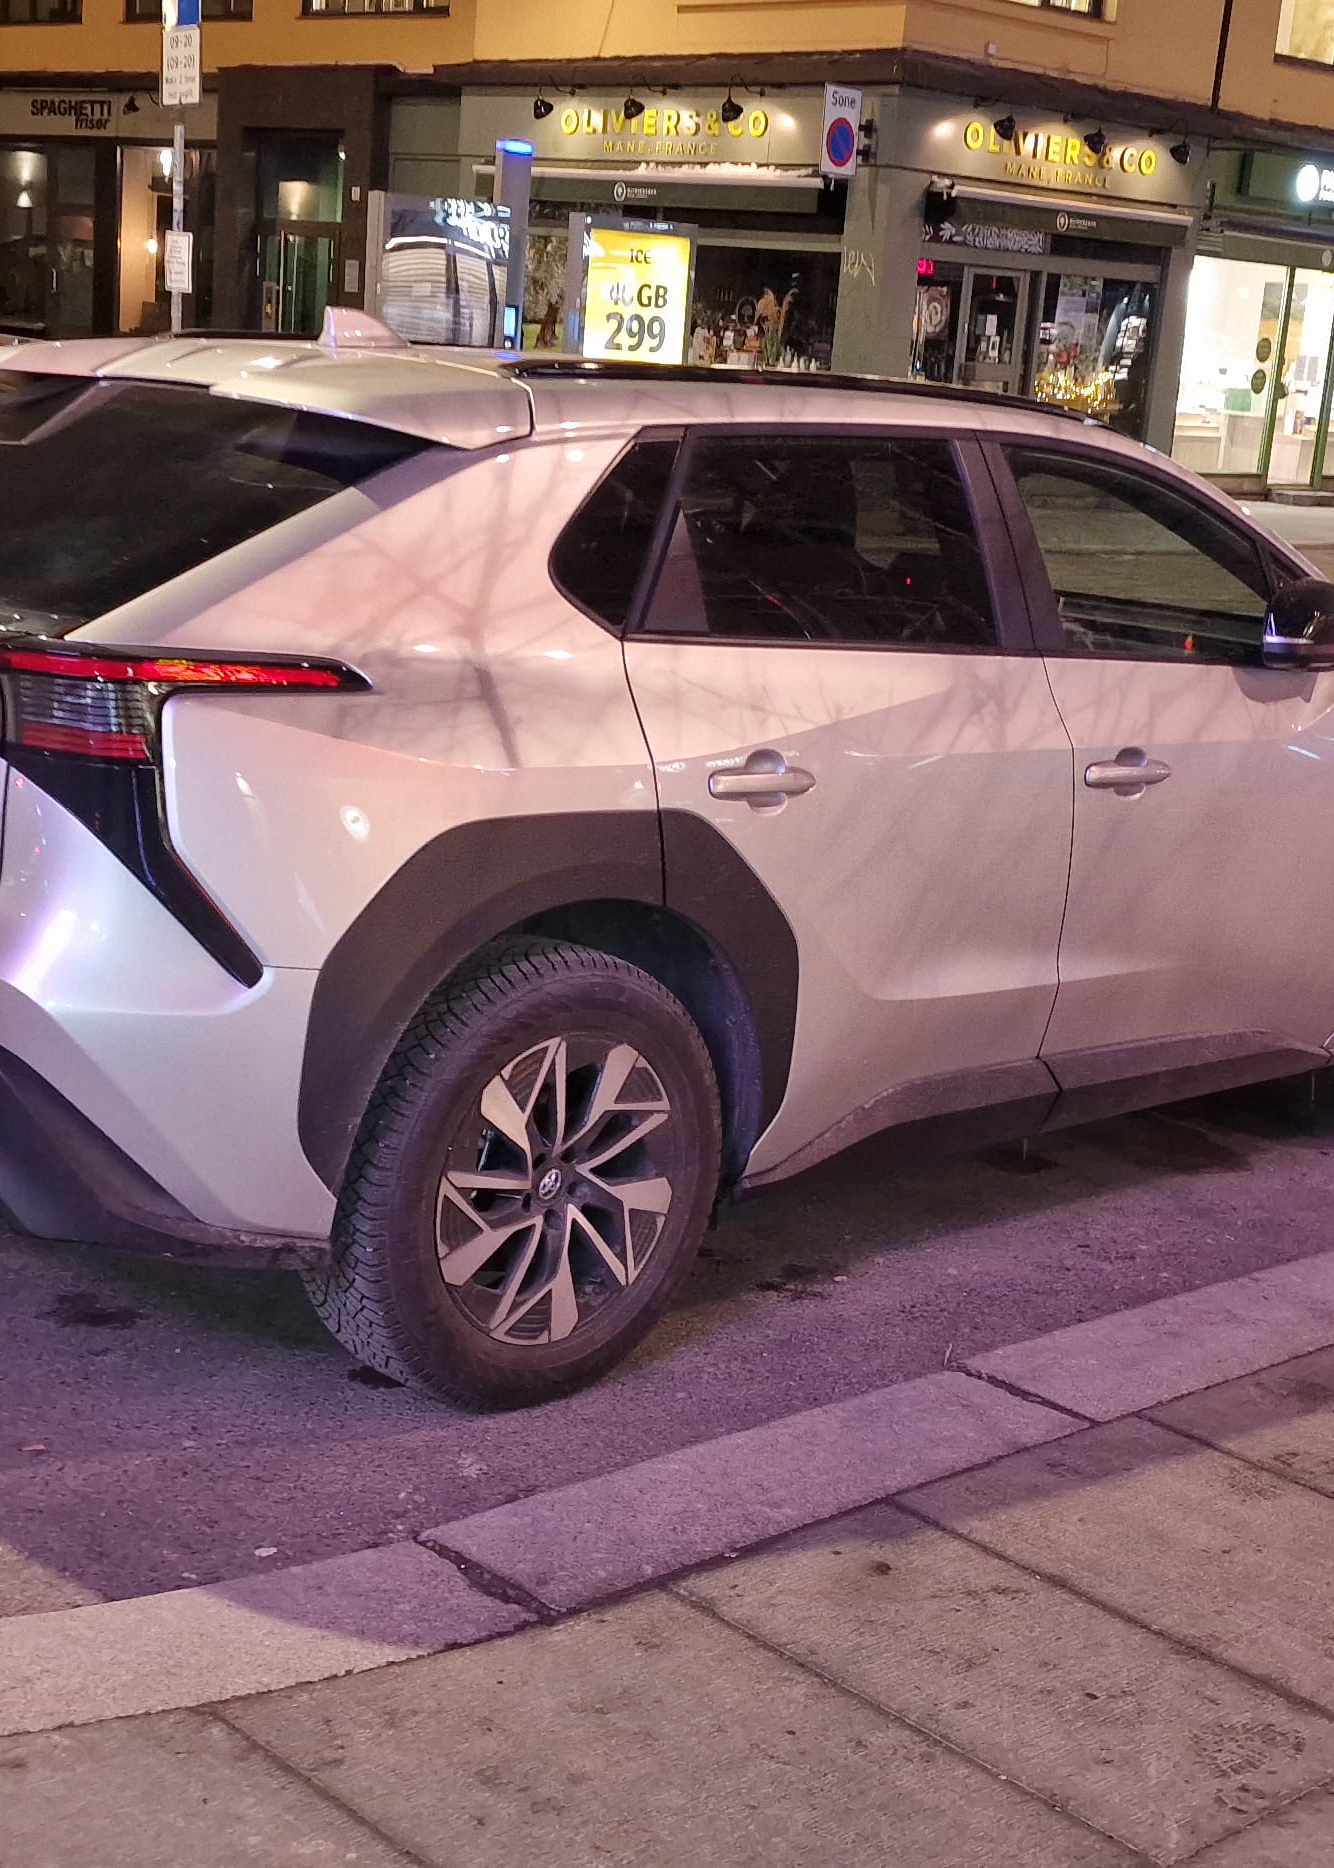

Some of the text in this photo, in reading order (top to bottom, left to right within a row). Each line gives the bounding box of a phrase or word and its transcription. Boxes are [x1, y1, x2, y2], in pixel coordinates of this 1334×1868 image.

[30, 98, 112, 117] SPAGHETTI
[831, 90, 857, 109] Sone
[655, 142, 718, 156] FRANCE
[1055, 168, 1110, 189] FRANCE
[604, 311, 666, 353] 299
